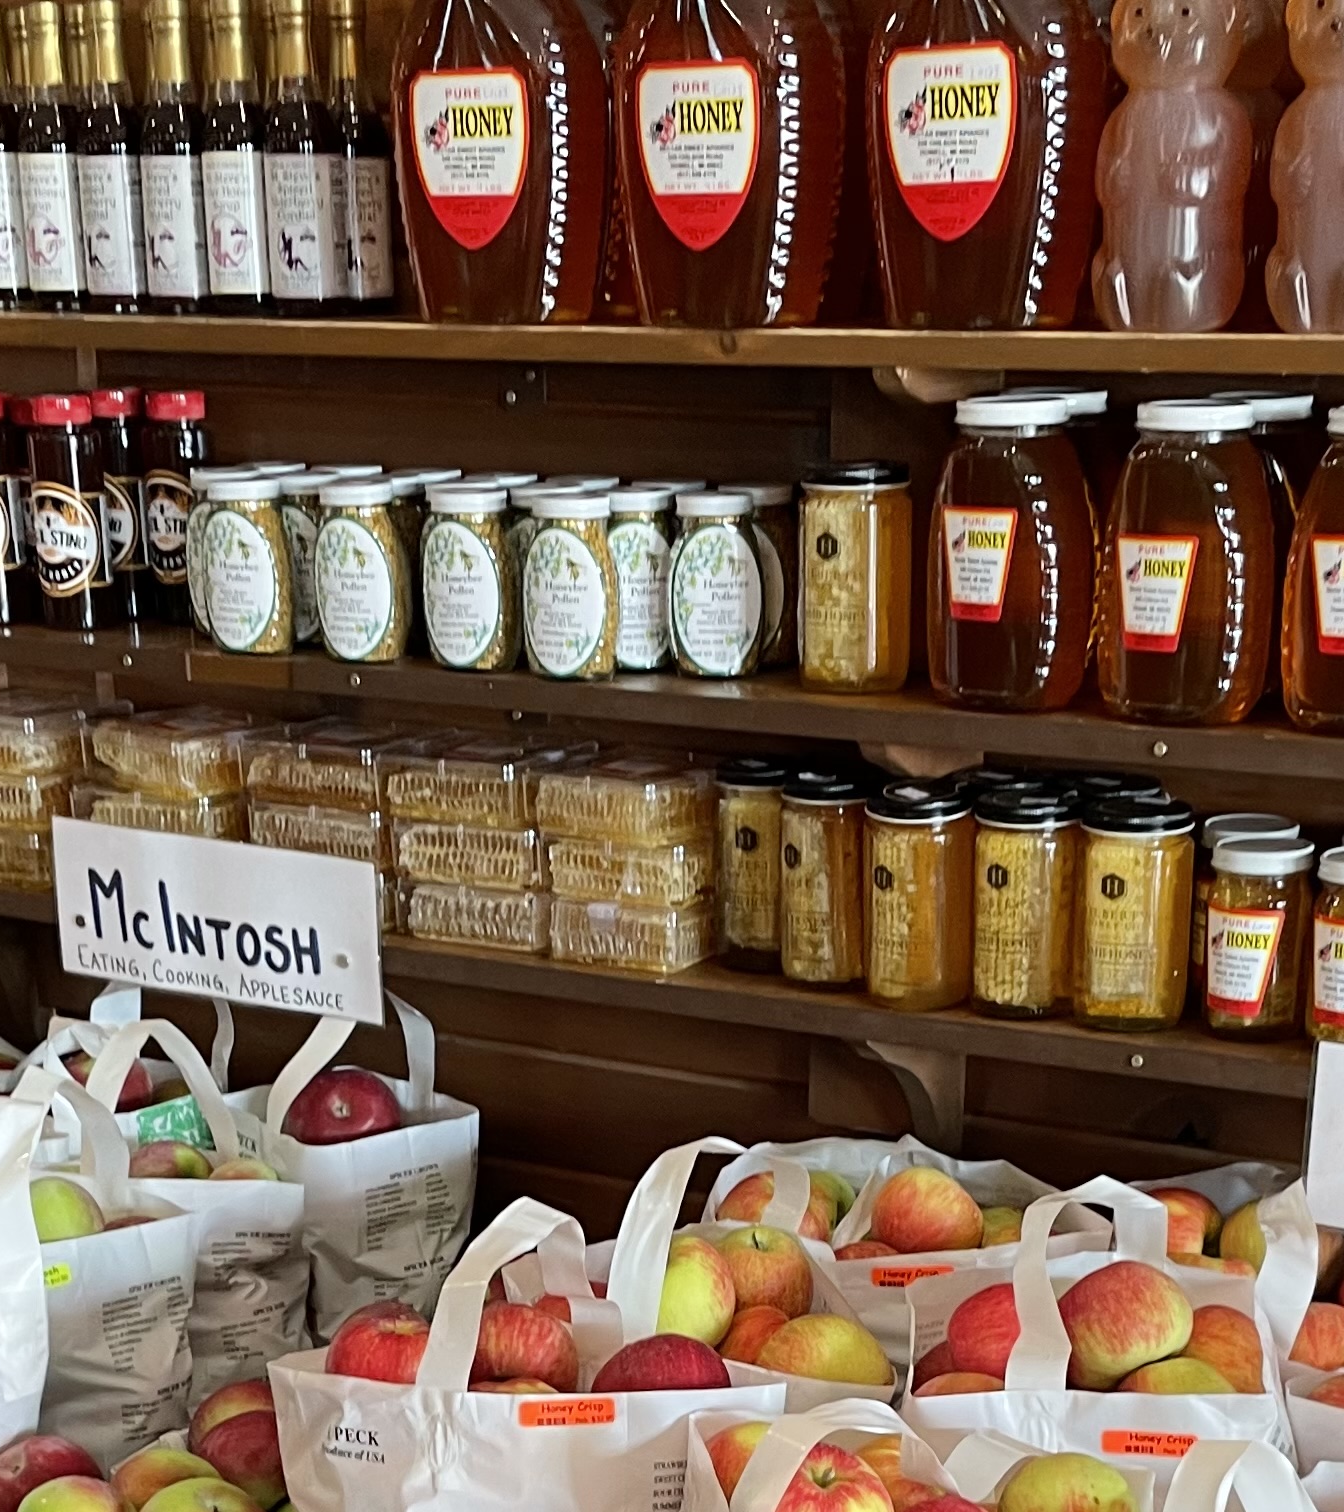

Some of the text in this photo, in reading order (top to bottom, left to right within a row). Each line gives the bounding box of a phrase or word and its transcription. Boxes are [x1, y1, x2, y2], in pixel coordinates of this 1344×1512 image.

[923, 65, 963, 78] PURE
[445, 87, 481, 101] PURE
[672, 81, 710, 94] PURE
[930, 83, 999, 120] HONEY
[452, 106, 513, 138] HONEY
[679, 100, 743, 133] HONEY
[962, 516, 987, 526] PURE
[968, 531, 1006, 549] HONEY
[1138, 544, 1165, 555] PURE
[1144, 560, 1186, 578] HONEY
[448, 585, 474, 596] Pollen
[711, 591, 741, 602] Pollen
[552, 594, 580, 605] Pollen
[1221, 916, 1250, 929] PURE
[1226, 931, 1271, 950] HONEY
[77, 944, 344, 1011] EATING, COOKING, APPLESAUCE
[883, 1269, 912, 1280] Honey
[541, 1401, 604, 1415] Honey Crisp
[334, 1426, 380, 1447] PECK
[1129, 1432, 1193, 1447] Honey Crisp
[354, 1449, 385, 1465] of USA
